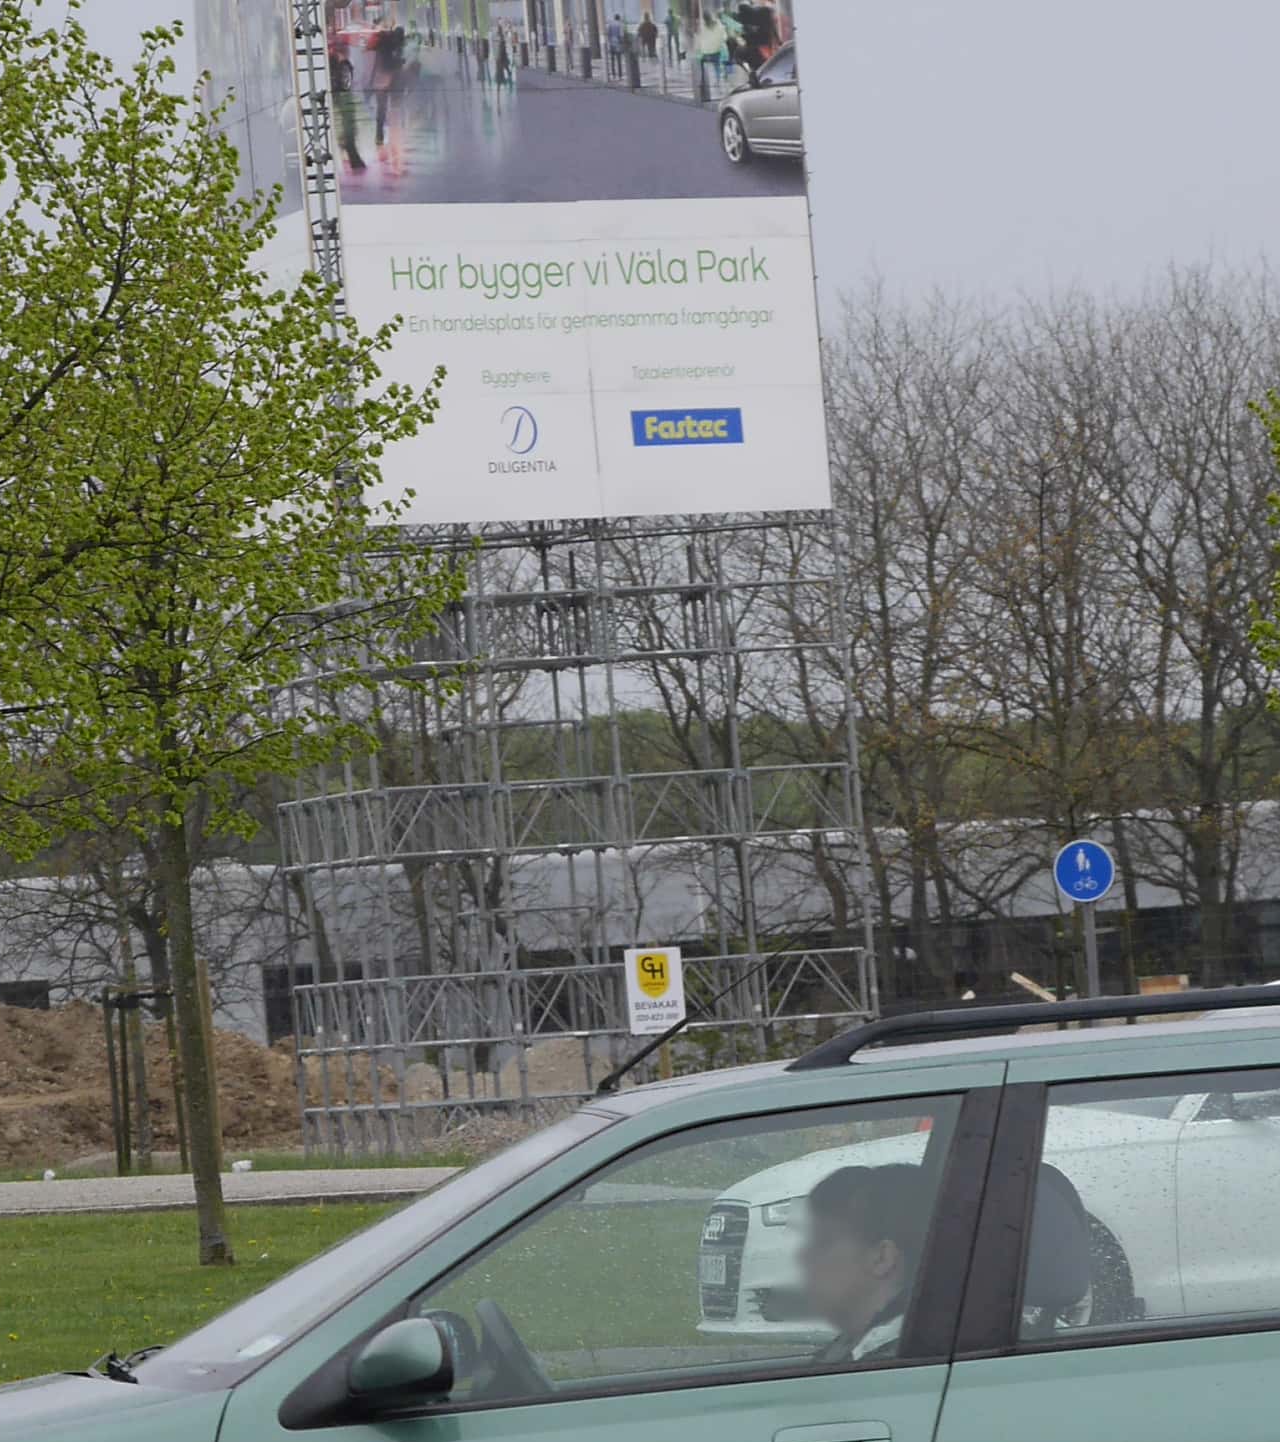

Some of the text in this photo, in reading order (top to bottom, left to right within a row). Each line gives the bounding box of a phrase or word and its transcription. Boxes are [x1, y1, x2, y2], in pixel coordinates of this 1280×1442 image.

[390, 247, 770, 300] Här bygger vi Väla Park
[408, 315, 432, 333] En
[432, 312, 535, 335] handelsplats
[561, 312, 678, 334] gemensamma
[680, 305, 773, 329] framgångar
[645, 415, 729, 440] Fastec
[488, 460, 557, 474] DILIGENTIA
